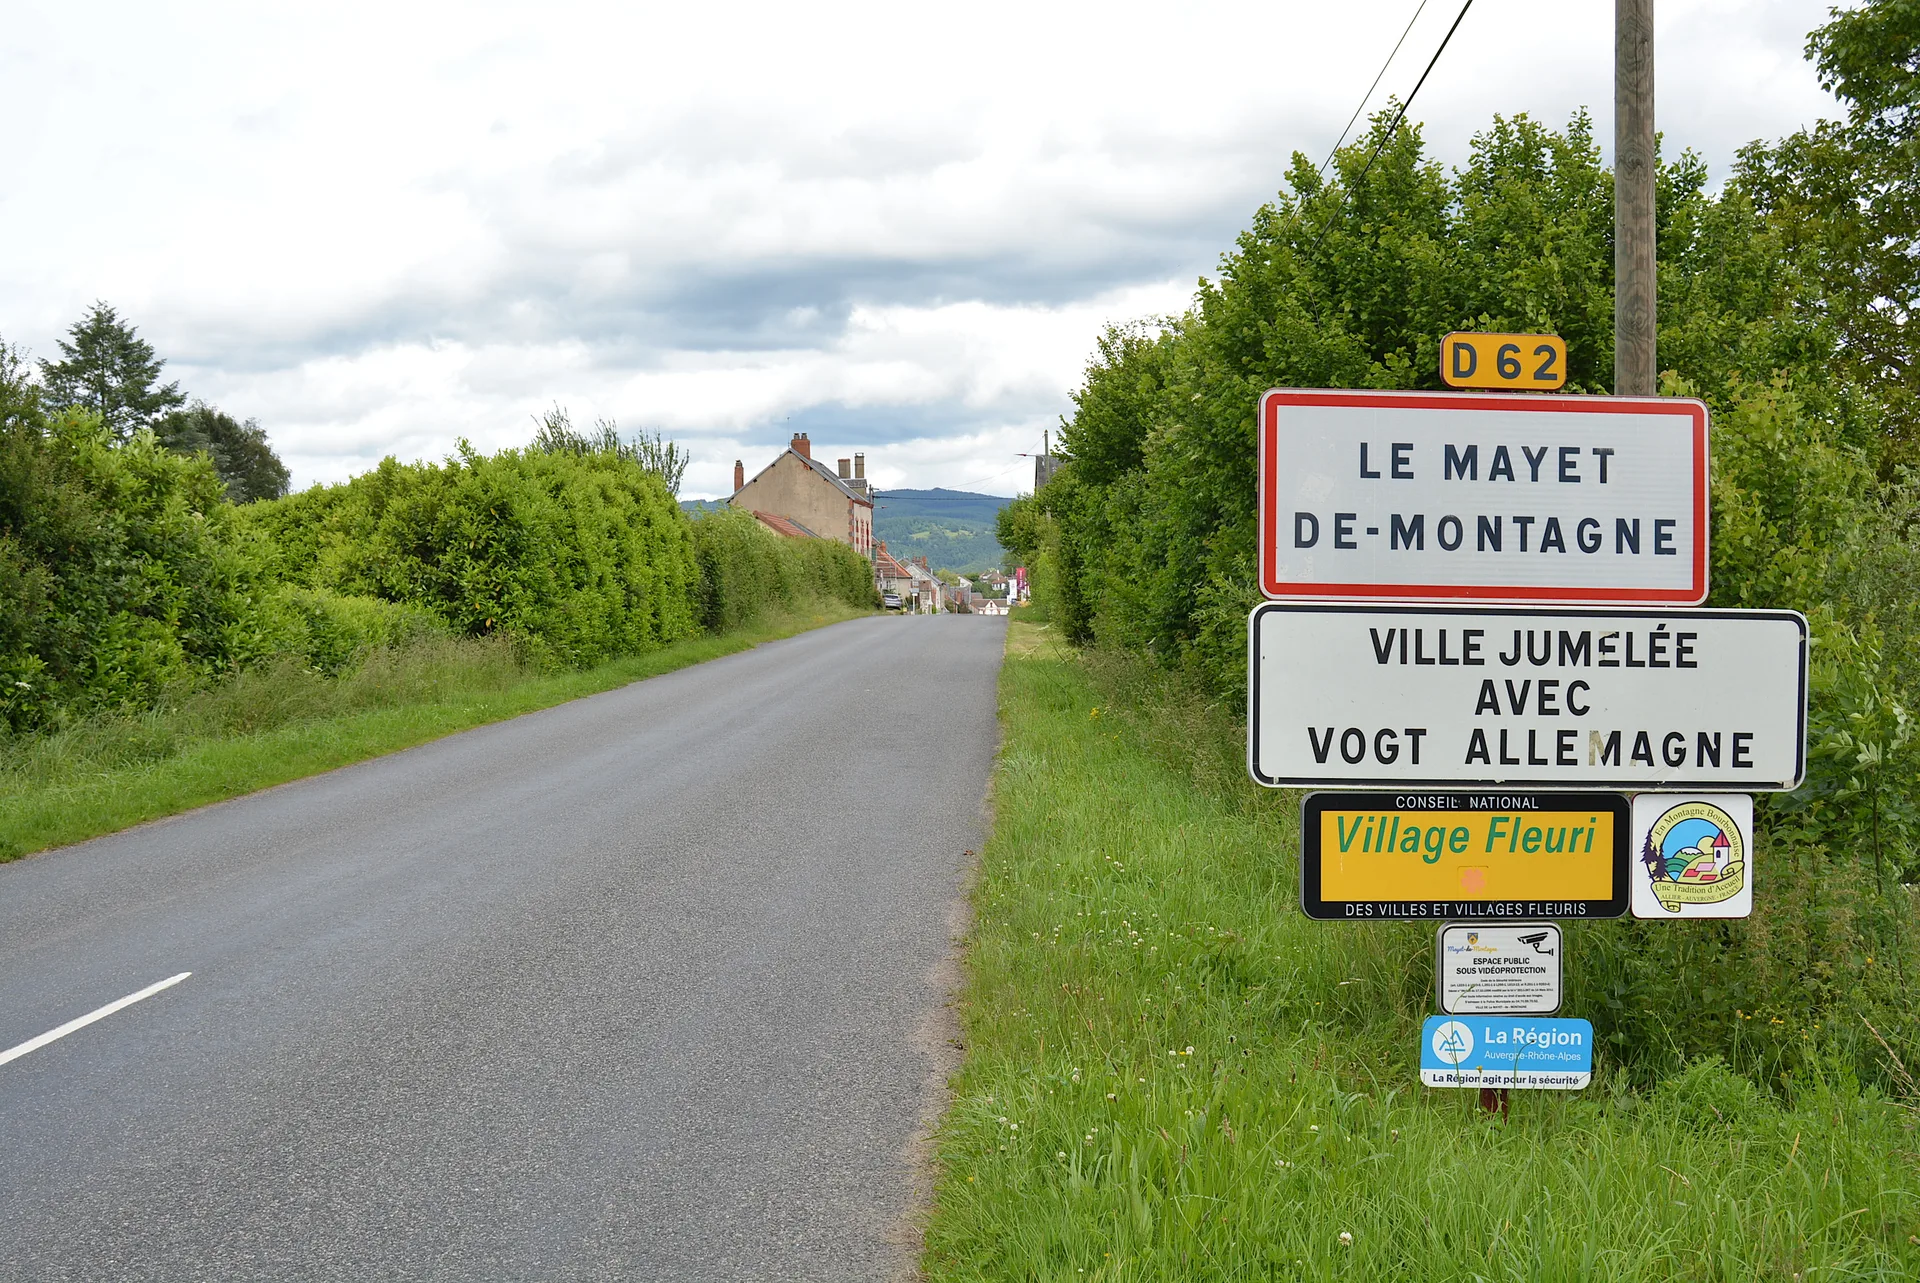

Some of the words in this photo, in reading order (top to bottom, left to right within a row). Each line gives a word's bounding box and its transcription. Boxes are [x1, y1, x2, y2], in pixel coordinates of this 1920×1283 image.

[1453, 342, 1477, 379] D
[1497, 343, 1558, 380] 62
[1359, 442, 1415, 480] LE
[1444, 443, 1615, 484] MAYET
[1294, 511, 1677, 556] DE-MONTAGNE
[1369, 627, 1485, 666] VILLE
[1499, 624, 1699, 669] JUMELÉE
[1474, 679, 1591, 716] AVEC
[1307, 726, 1427, 765] VOGT
[1464, 728, 1755, 769] ALLEMAGNE
[1395, 796, 1458, 809] CONSEIL
[1469, 796, 1539, 809] NATIONAL
[1336, 816, 1470, 864] Village
[1485, 816, 1597, 854] Fleuri
[1655, 825, 1666, 837] En
[1664, 808, 1705, 826] Montagne
[1707, 809, 1740, 858] Bourbonnaise
[1655, 884, 1671, 892] Une
[1673, 884, 1706, 894] Tradition
[1707, 876, 1741, 894] d'Accueil
[1686, 894, 1717, 902] AUVERGNE
[1719, 886, 1740, 899] FRANCE
[1345, 904, 1373, 917] DES
[1379, 903, 1428, 916] VILLES
[1433, 903, 1449, 916] ET
[1455, 903, 1523, 916] VILLAGES
[1528, 903, 1587, 916] FLEURIS
[1456, 967, 1477, 975] SOUS
[1478, 966, 1546, 975] VIDÉOPROTECTION
[1473, 957, 1502, 965] ESPACE
[1503, 957, 1530, 965] PUBLIC
[1485, 1027, 1507, 1044] La
[1513, 1027, 1582, 1048] Région
[1485, 1050, 1581, 1062] Auvergne-Rhône-Alpes
[1432, 1073, 1444, 1083] La
[1446, 1073, 1480, 1085] Région
[1482, 1074, 1502, 1085] agit
[1503, 1076, 1527, 1086] pour
[1528, 1075, 1537, 1084] la
[1538, 1075, 1579, 1085] sécurité
